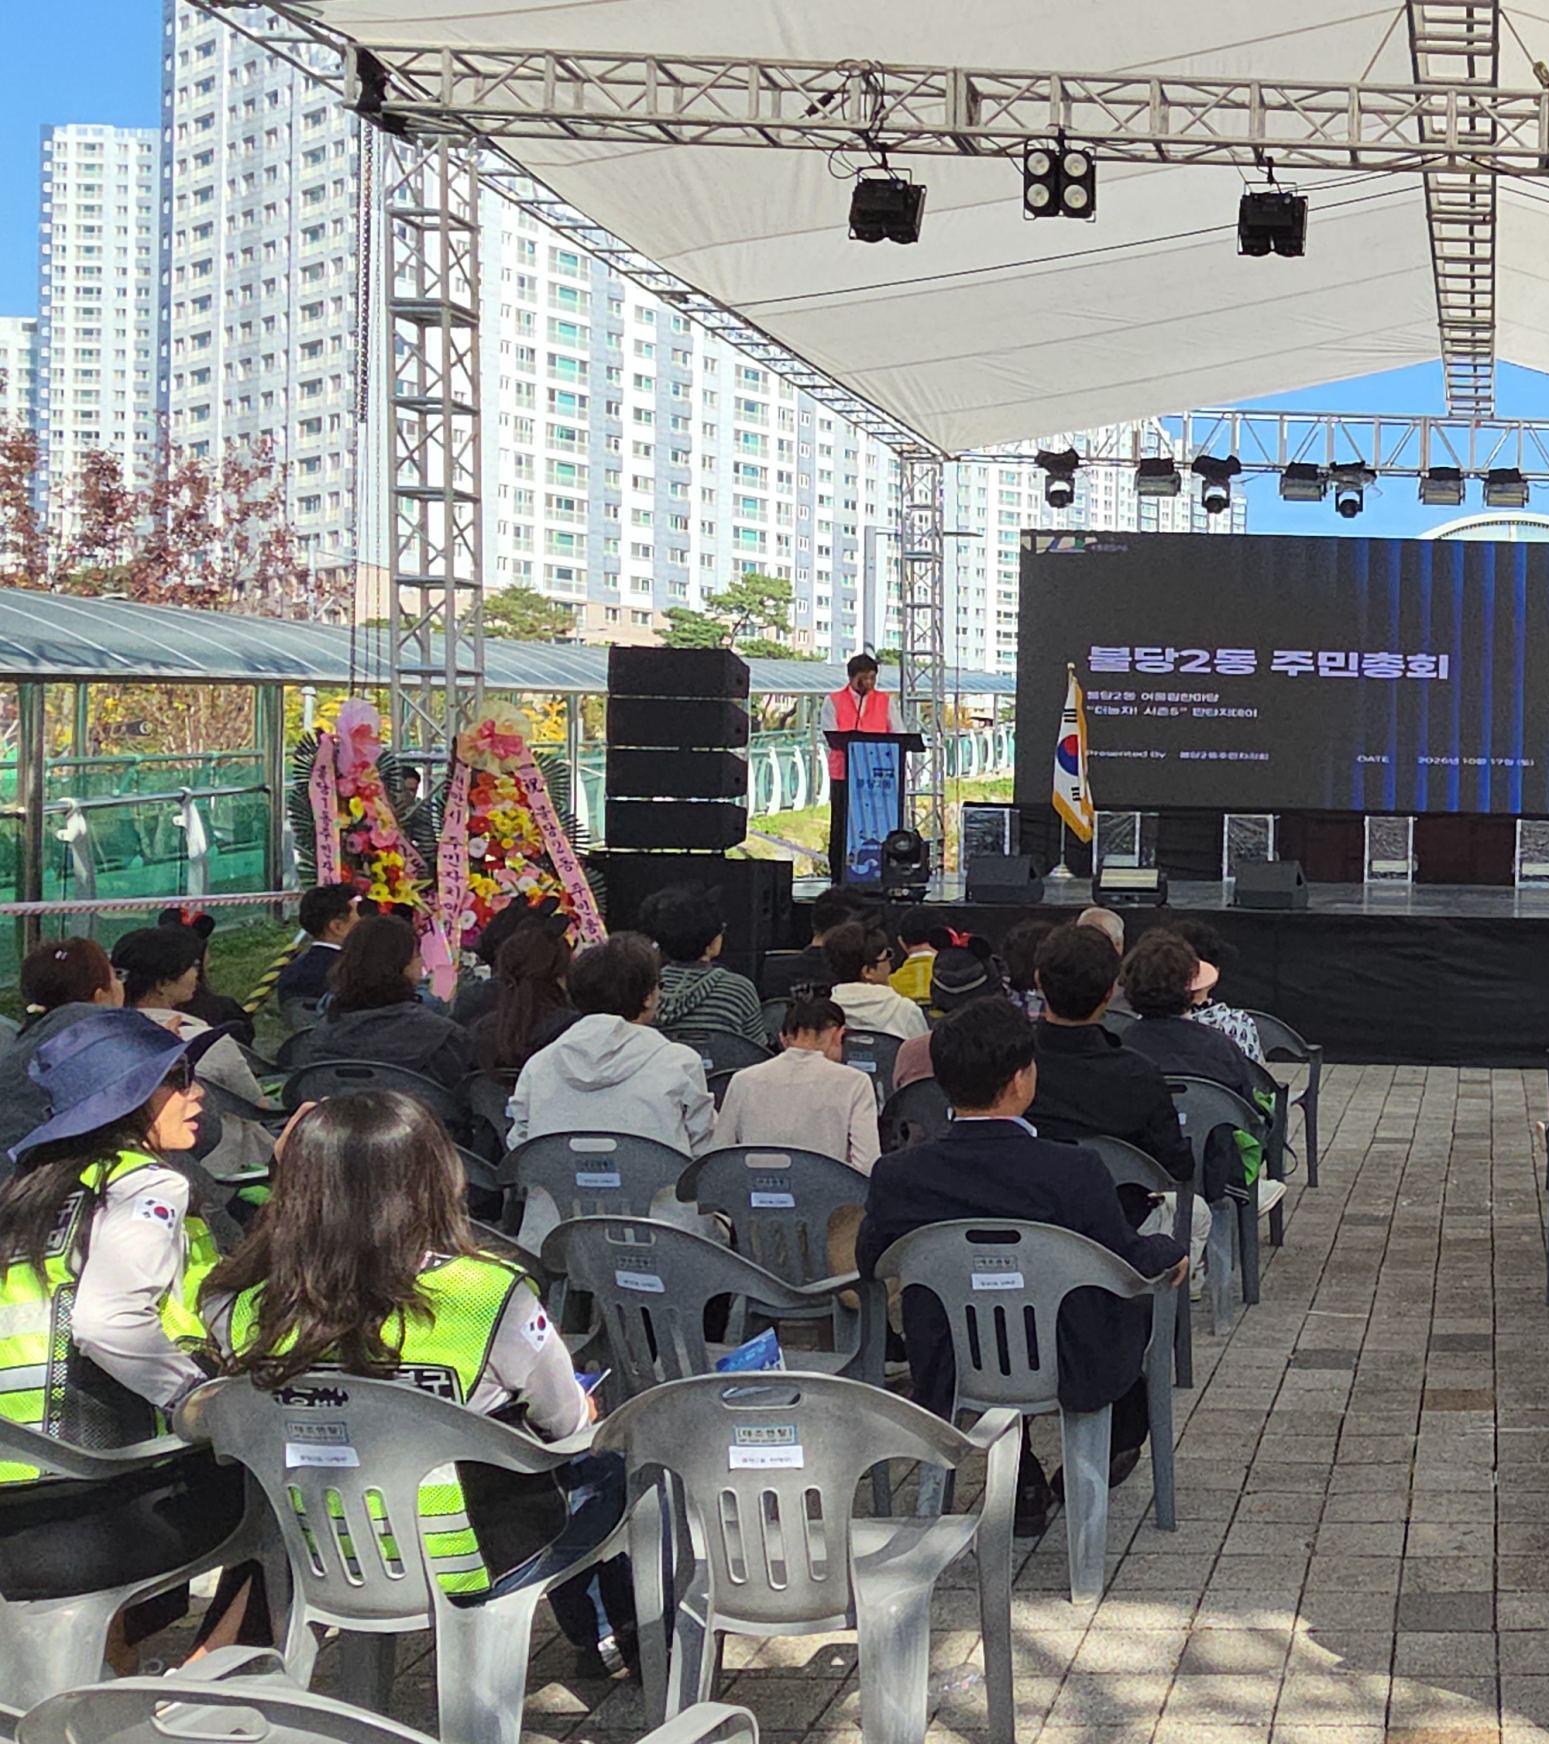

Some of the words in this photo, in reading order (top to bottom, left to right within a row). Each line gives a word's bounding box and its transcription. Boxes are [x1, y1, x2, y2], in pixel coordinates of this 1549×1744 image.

[1088, 646, 1258, 676] 불당2동
[1270, 650, 1450, 680] 주민총회
[1087, 691, 1136, 701] 불당2동
[1357, 755, 1389, 763] DATE
